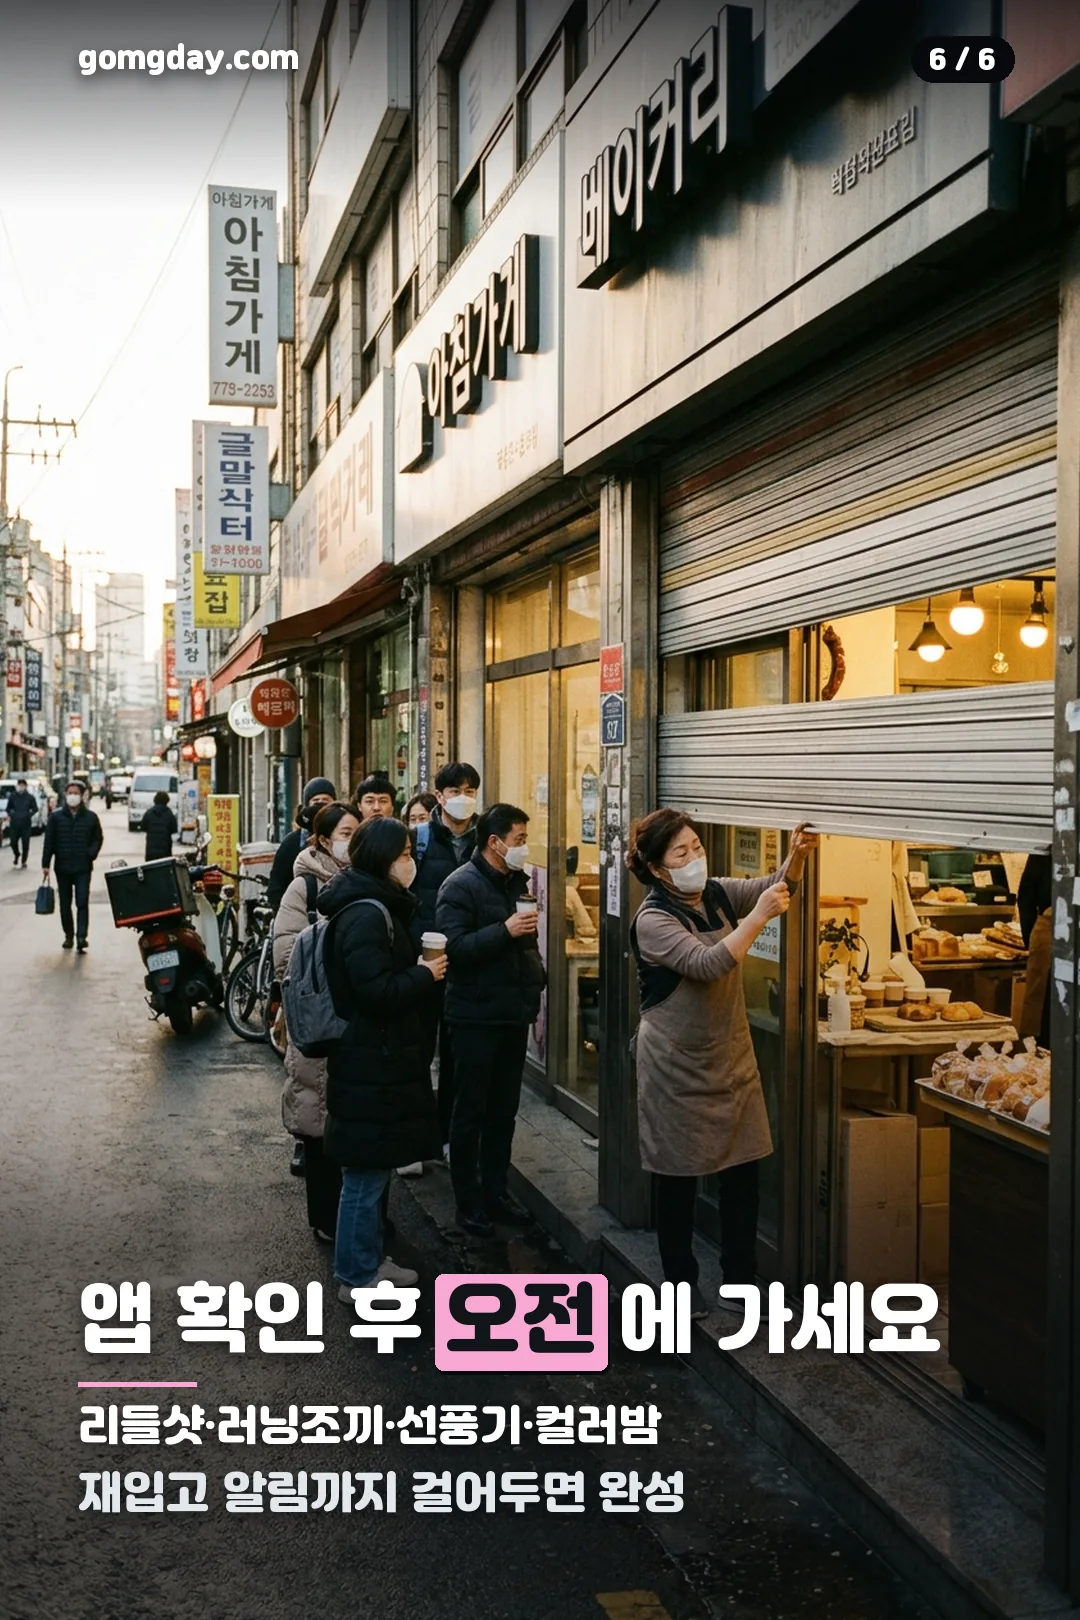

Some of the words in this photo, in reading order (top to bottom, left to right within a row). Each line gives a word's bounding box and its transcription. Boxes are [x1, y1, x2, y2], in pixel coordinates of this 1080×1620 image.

[579, 5, 746, 278] 베이커리
[224, 216, 264, 375] 아침가게
[427, 234, 539, 427] 아침가게
